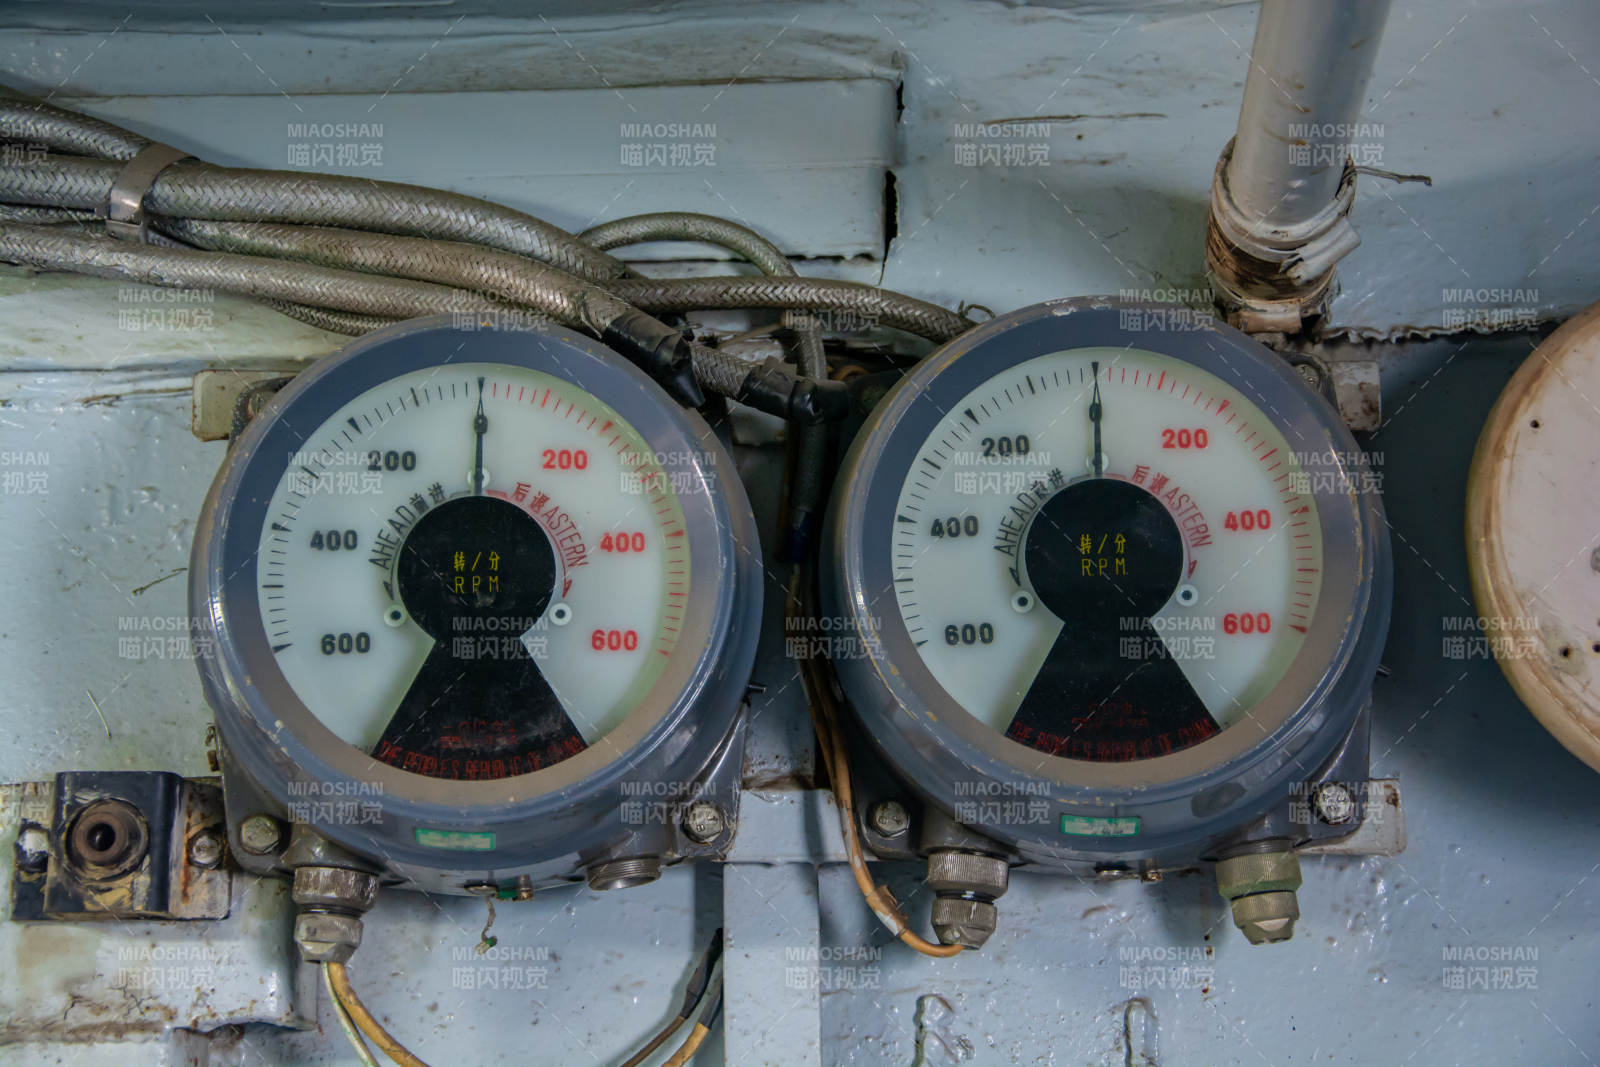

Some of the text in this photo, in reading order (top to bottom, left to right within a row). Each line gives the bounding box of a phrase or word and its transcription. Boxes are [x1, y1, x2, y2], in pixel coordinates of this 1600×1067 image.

[981, 434, 1031, 457] 200
[1161, 428, 1209, 449] 200
[367, 451, 416, 472] 200
[542, 449, 588, 471] 200
[930, 516, 979, 539] 400
[1224, 509, 1272, 532] 400
[310, 530, 358, 552] 400
[600, 532, 646, 553] 400
[944, 622, 994, 646] 600
[1224, 612, 1272, 636] 600
[321, 633, 371, 656] 600
[591, 630, 639, 652] 600
